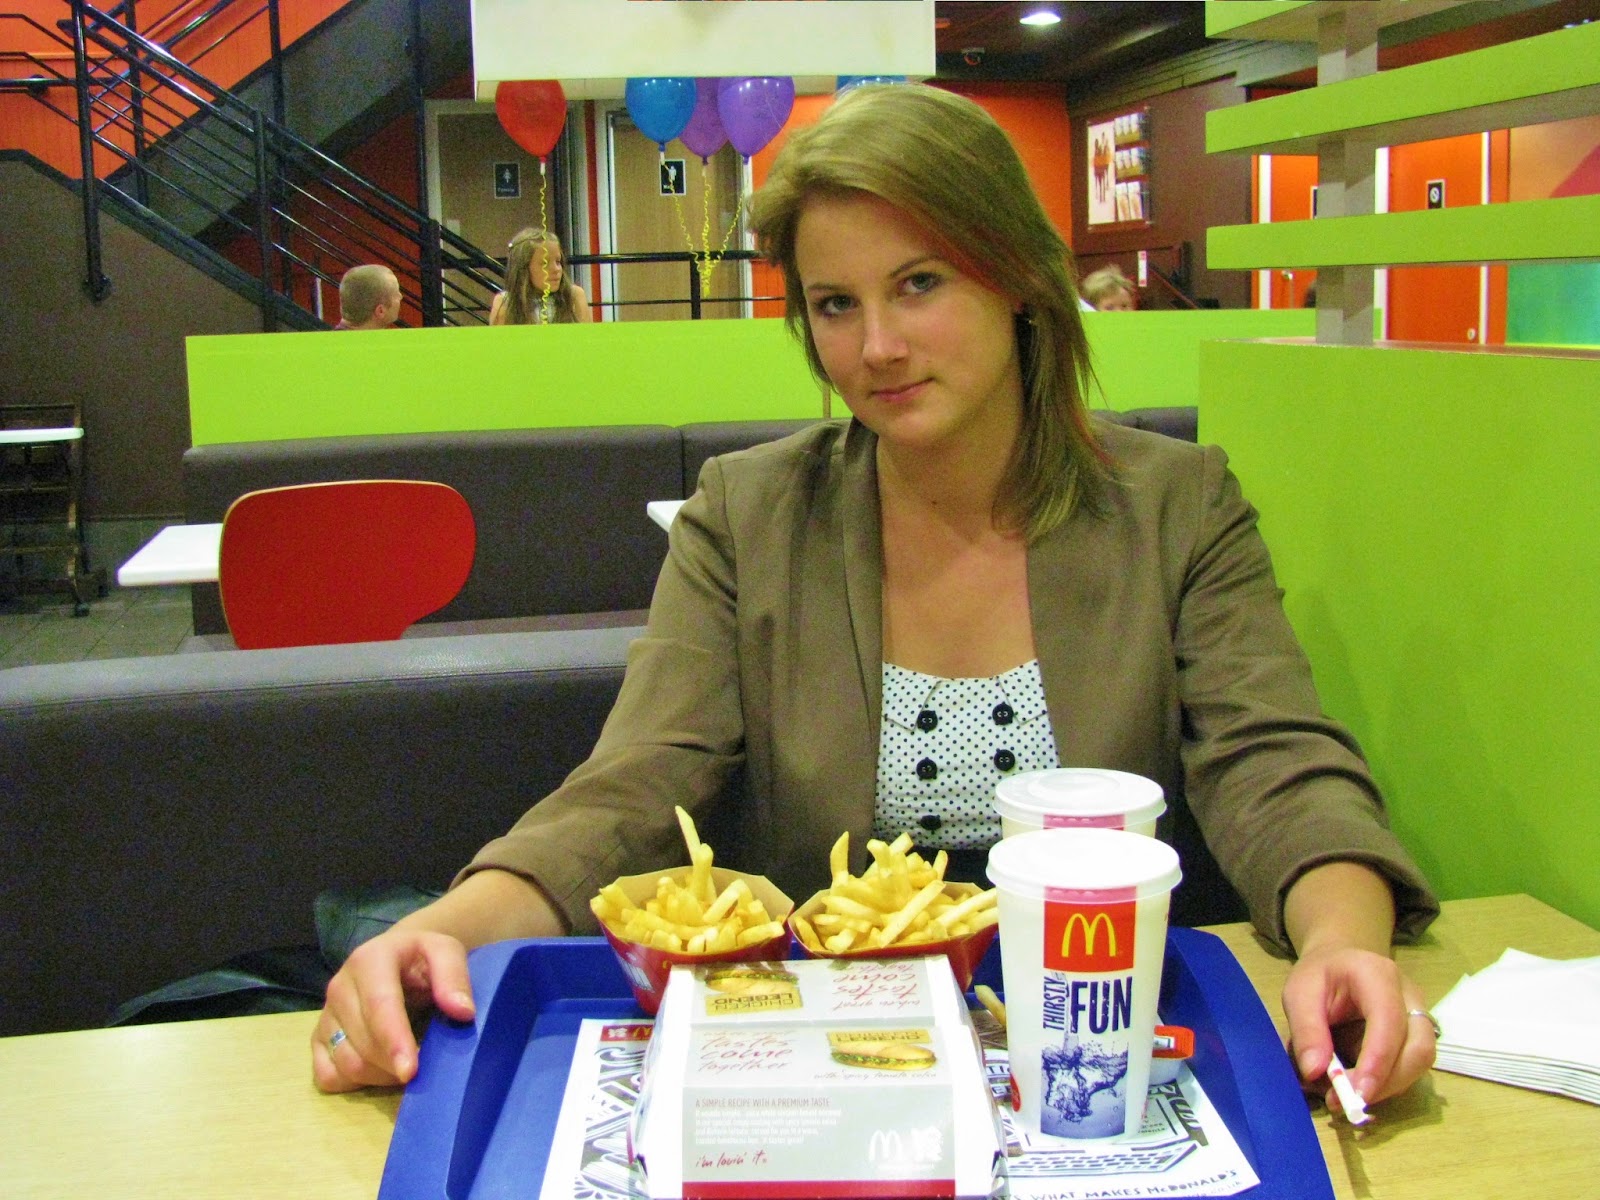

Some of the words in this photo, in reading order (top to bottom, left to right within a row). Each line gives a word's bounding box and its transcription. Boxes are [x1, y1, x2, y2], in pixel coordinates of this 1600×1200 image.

[832, 973, 916, 982] come
[714, 993, 793, 1005] LEGEND
[832, 983, 917, 1000] tastes
[715, 999, 794, 1011] CHICKEN
[1042, 976, 1066, 1030] THIRSTY
[1070, 976, 1133, 1034] FUN
[700, 1048, 793, 1059] come
[698, 1059, 792, 1075] together
[696, 1099, 701, 1107] A
[702, 1098, 726, 1107] SIMPLE
[728, 1098, 750, 1107] RECIPE
[753, 1098, 770, 1107] WITH
[771, 1098, 777, 1107] A
[778, 1098, 809, 1107] PREMIUM
[811, 1097, 830, 1106] TASTE
[696, 1155, 713, 1168] i'm
[717, 1152, 747, 1168] lovin'
[1030, 1192, 1075, 1200] WHAT
[1086, 1188, 1141, 1198] MAKES
[1147, 1170, 1237, 1194] McDONALD'S
